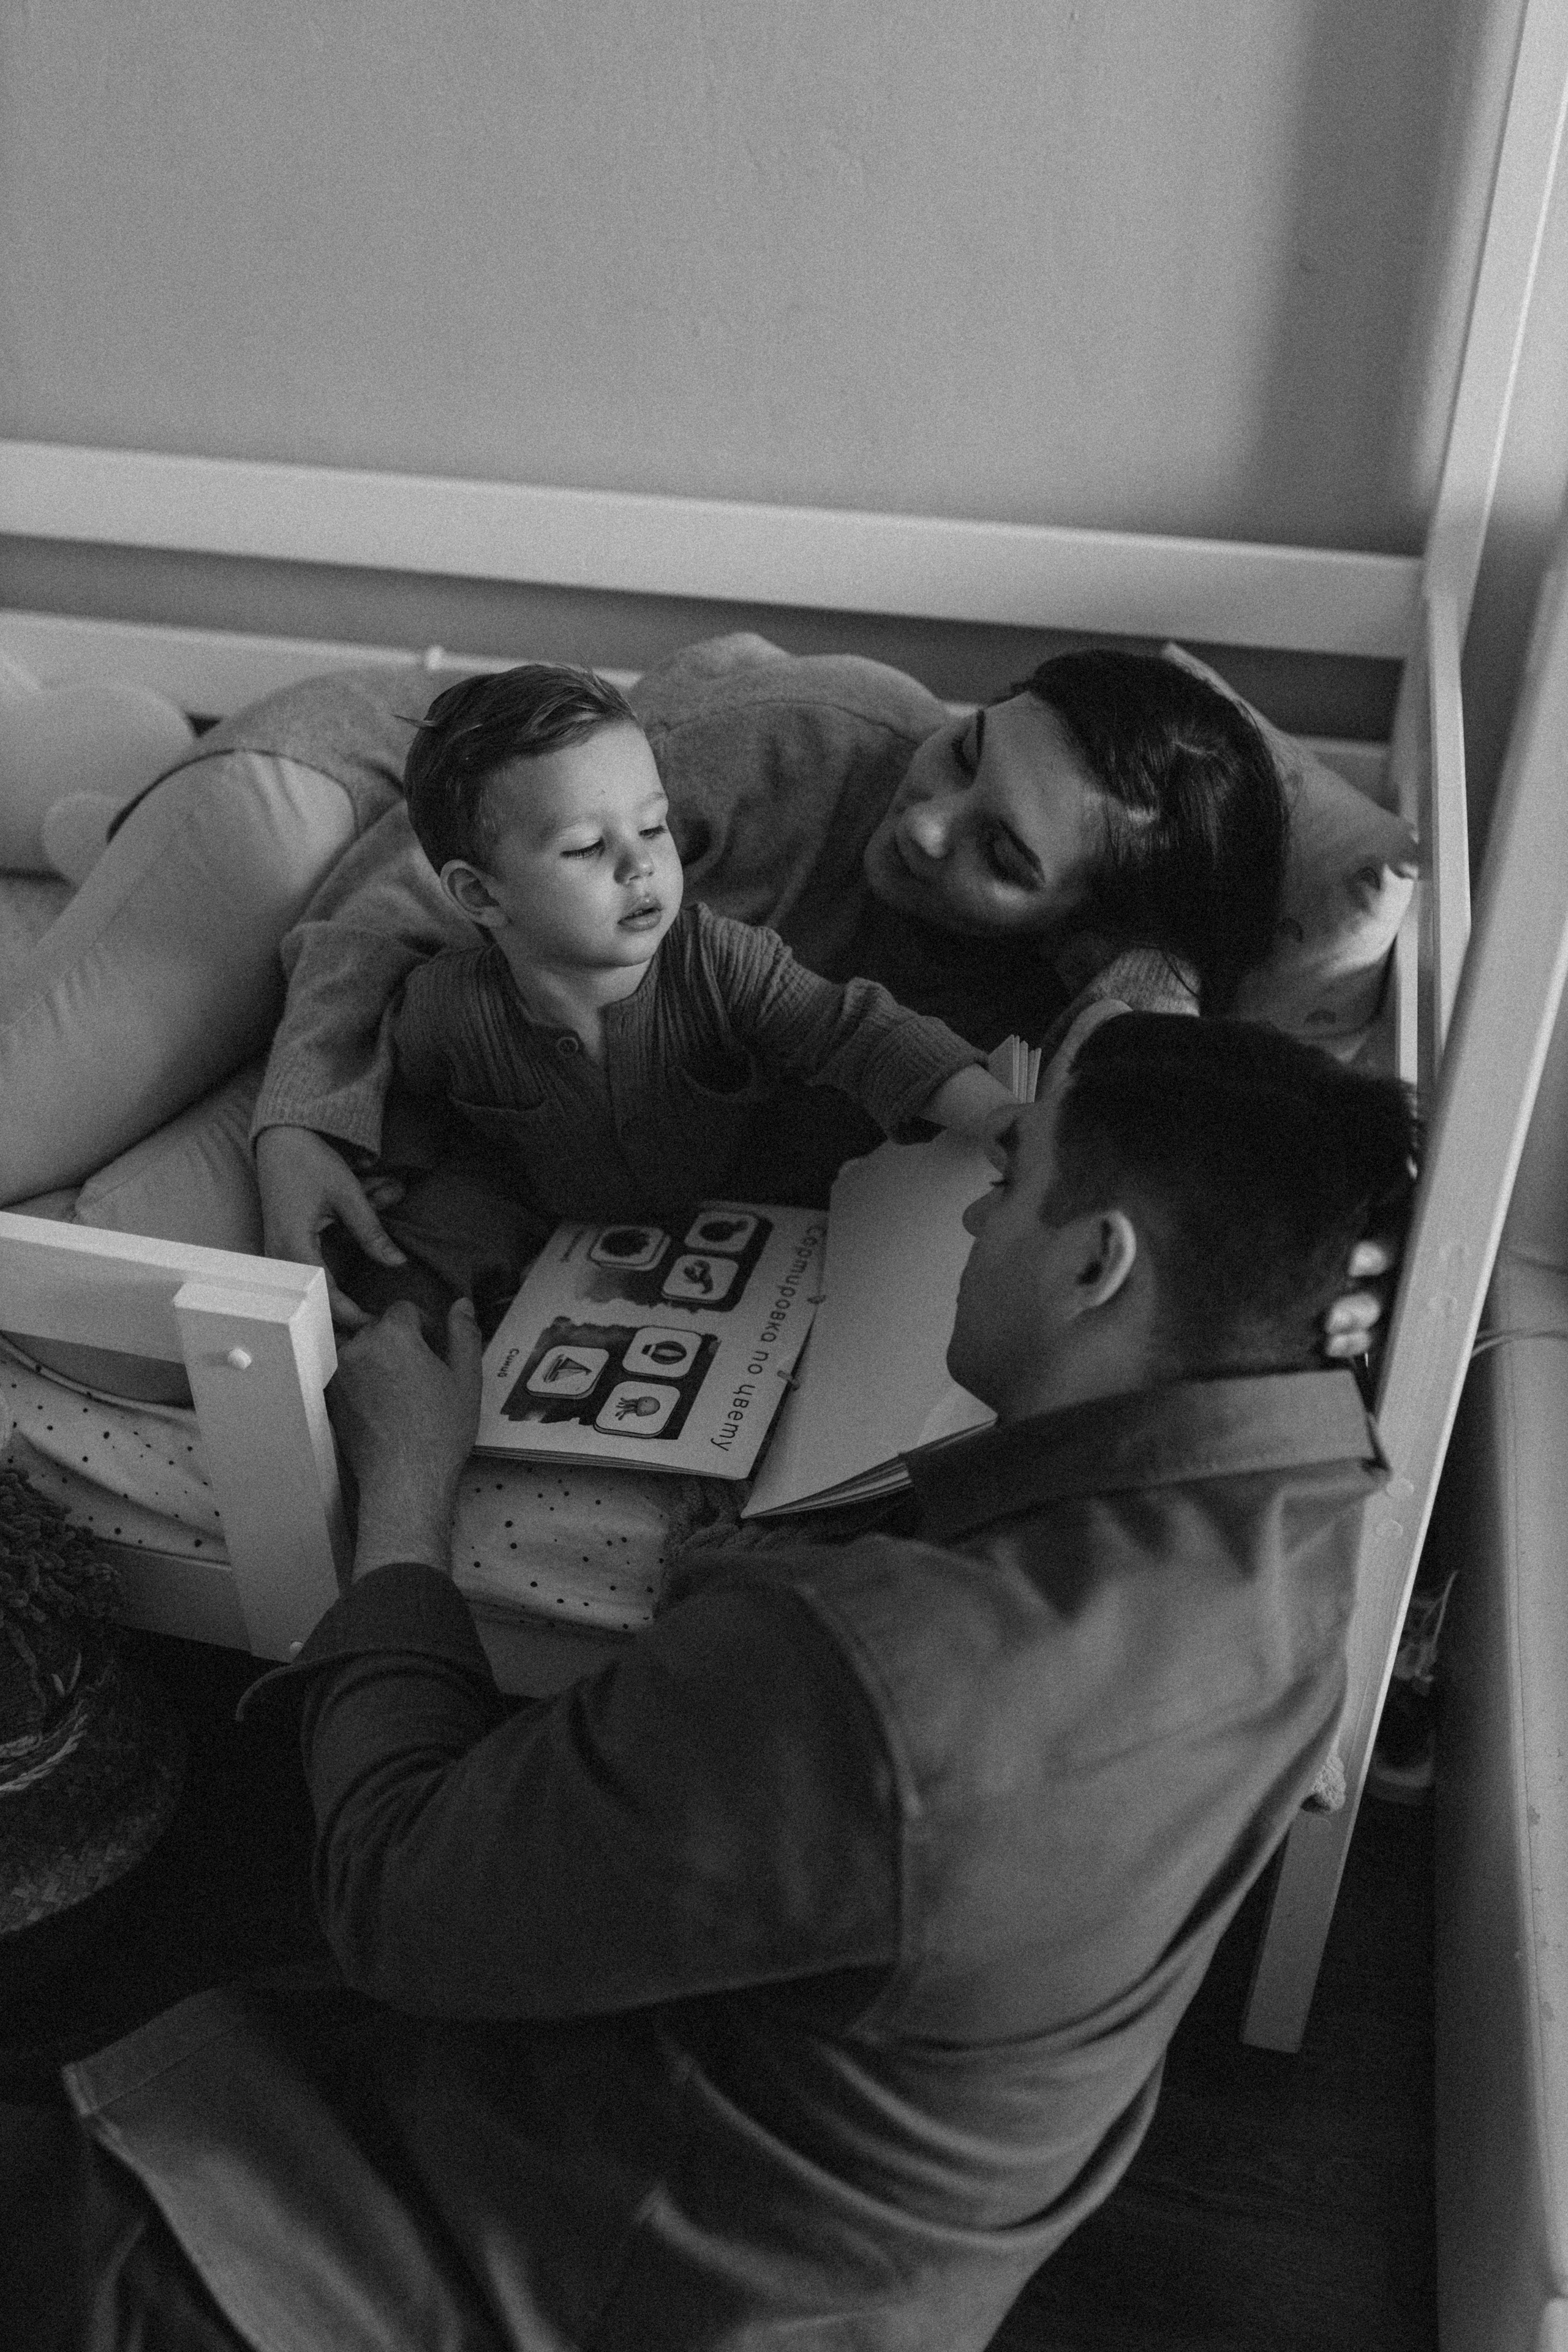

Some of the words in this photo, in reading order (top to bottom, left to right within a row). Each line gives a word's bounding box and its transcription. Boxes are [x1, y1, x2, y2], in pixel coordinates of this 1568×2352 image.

[761, 1225, 827, 1343] Сортировка
[497, 1348, 519, 1378] Синий
[748, 1351, 769, 1374] по
[710, 1384, 755, 1452] цвету
